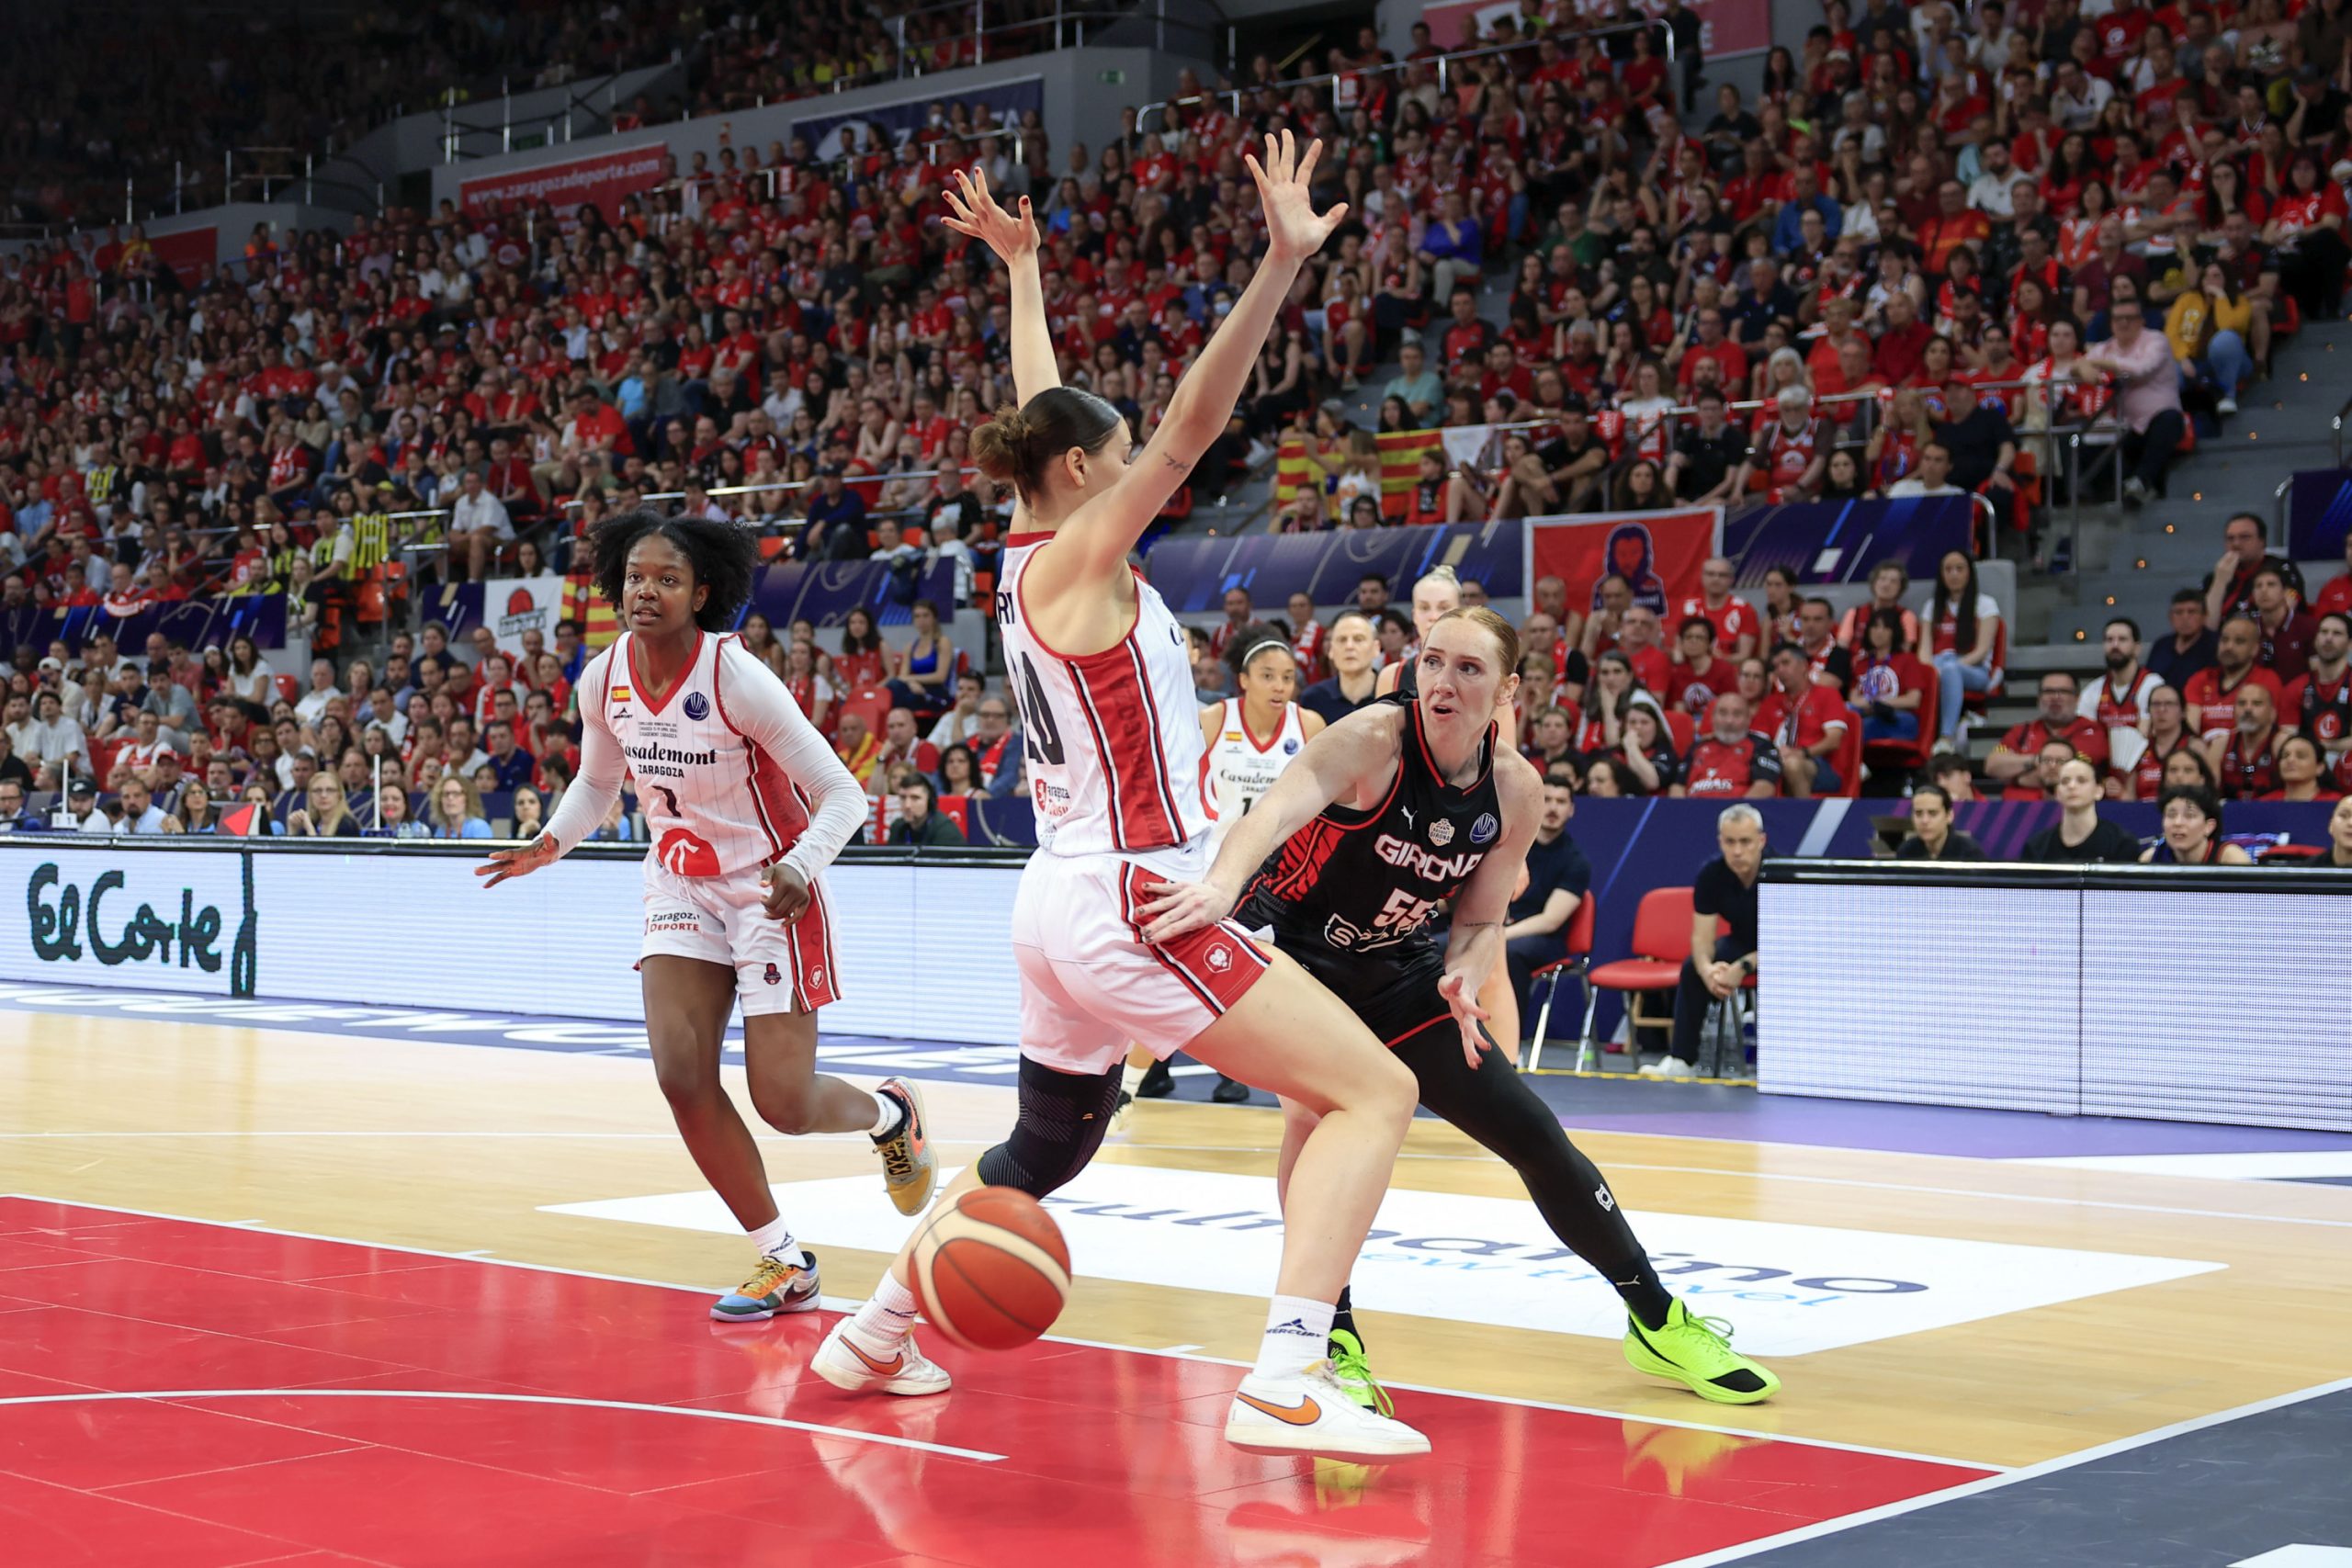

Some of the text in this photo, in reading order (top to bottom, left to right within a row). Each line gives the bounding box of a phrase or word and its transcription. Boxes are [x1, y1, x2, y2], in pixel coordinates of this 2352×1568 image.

[619, 739, 718, 765] asademont
[638, 764, 684, 778] ZARAGOZA
[1220, 768, 1277, 784] Casadem
[27, 862, 82, 961] El
[86, 869, 222, 973] Corte
[650, 923, 699, 932] DEPORTE
[0, 983, 427, 1022] GUE
[1360, 1252, 1846, 1307] ew trvel
